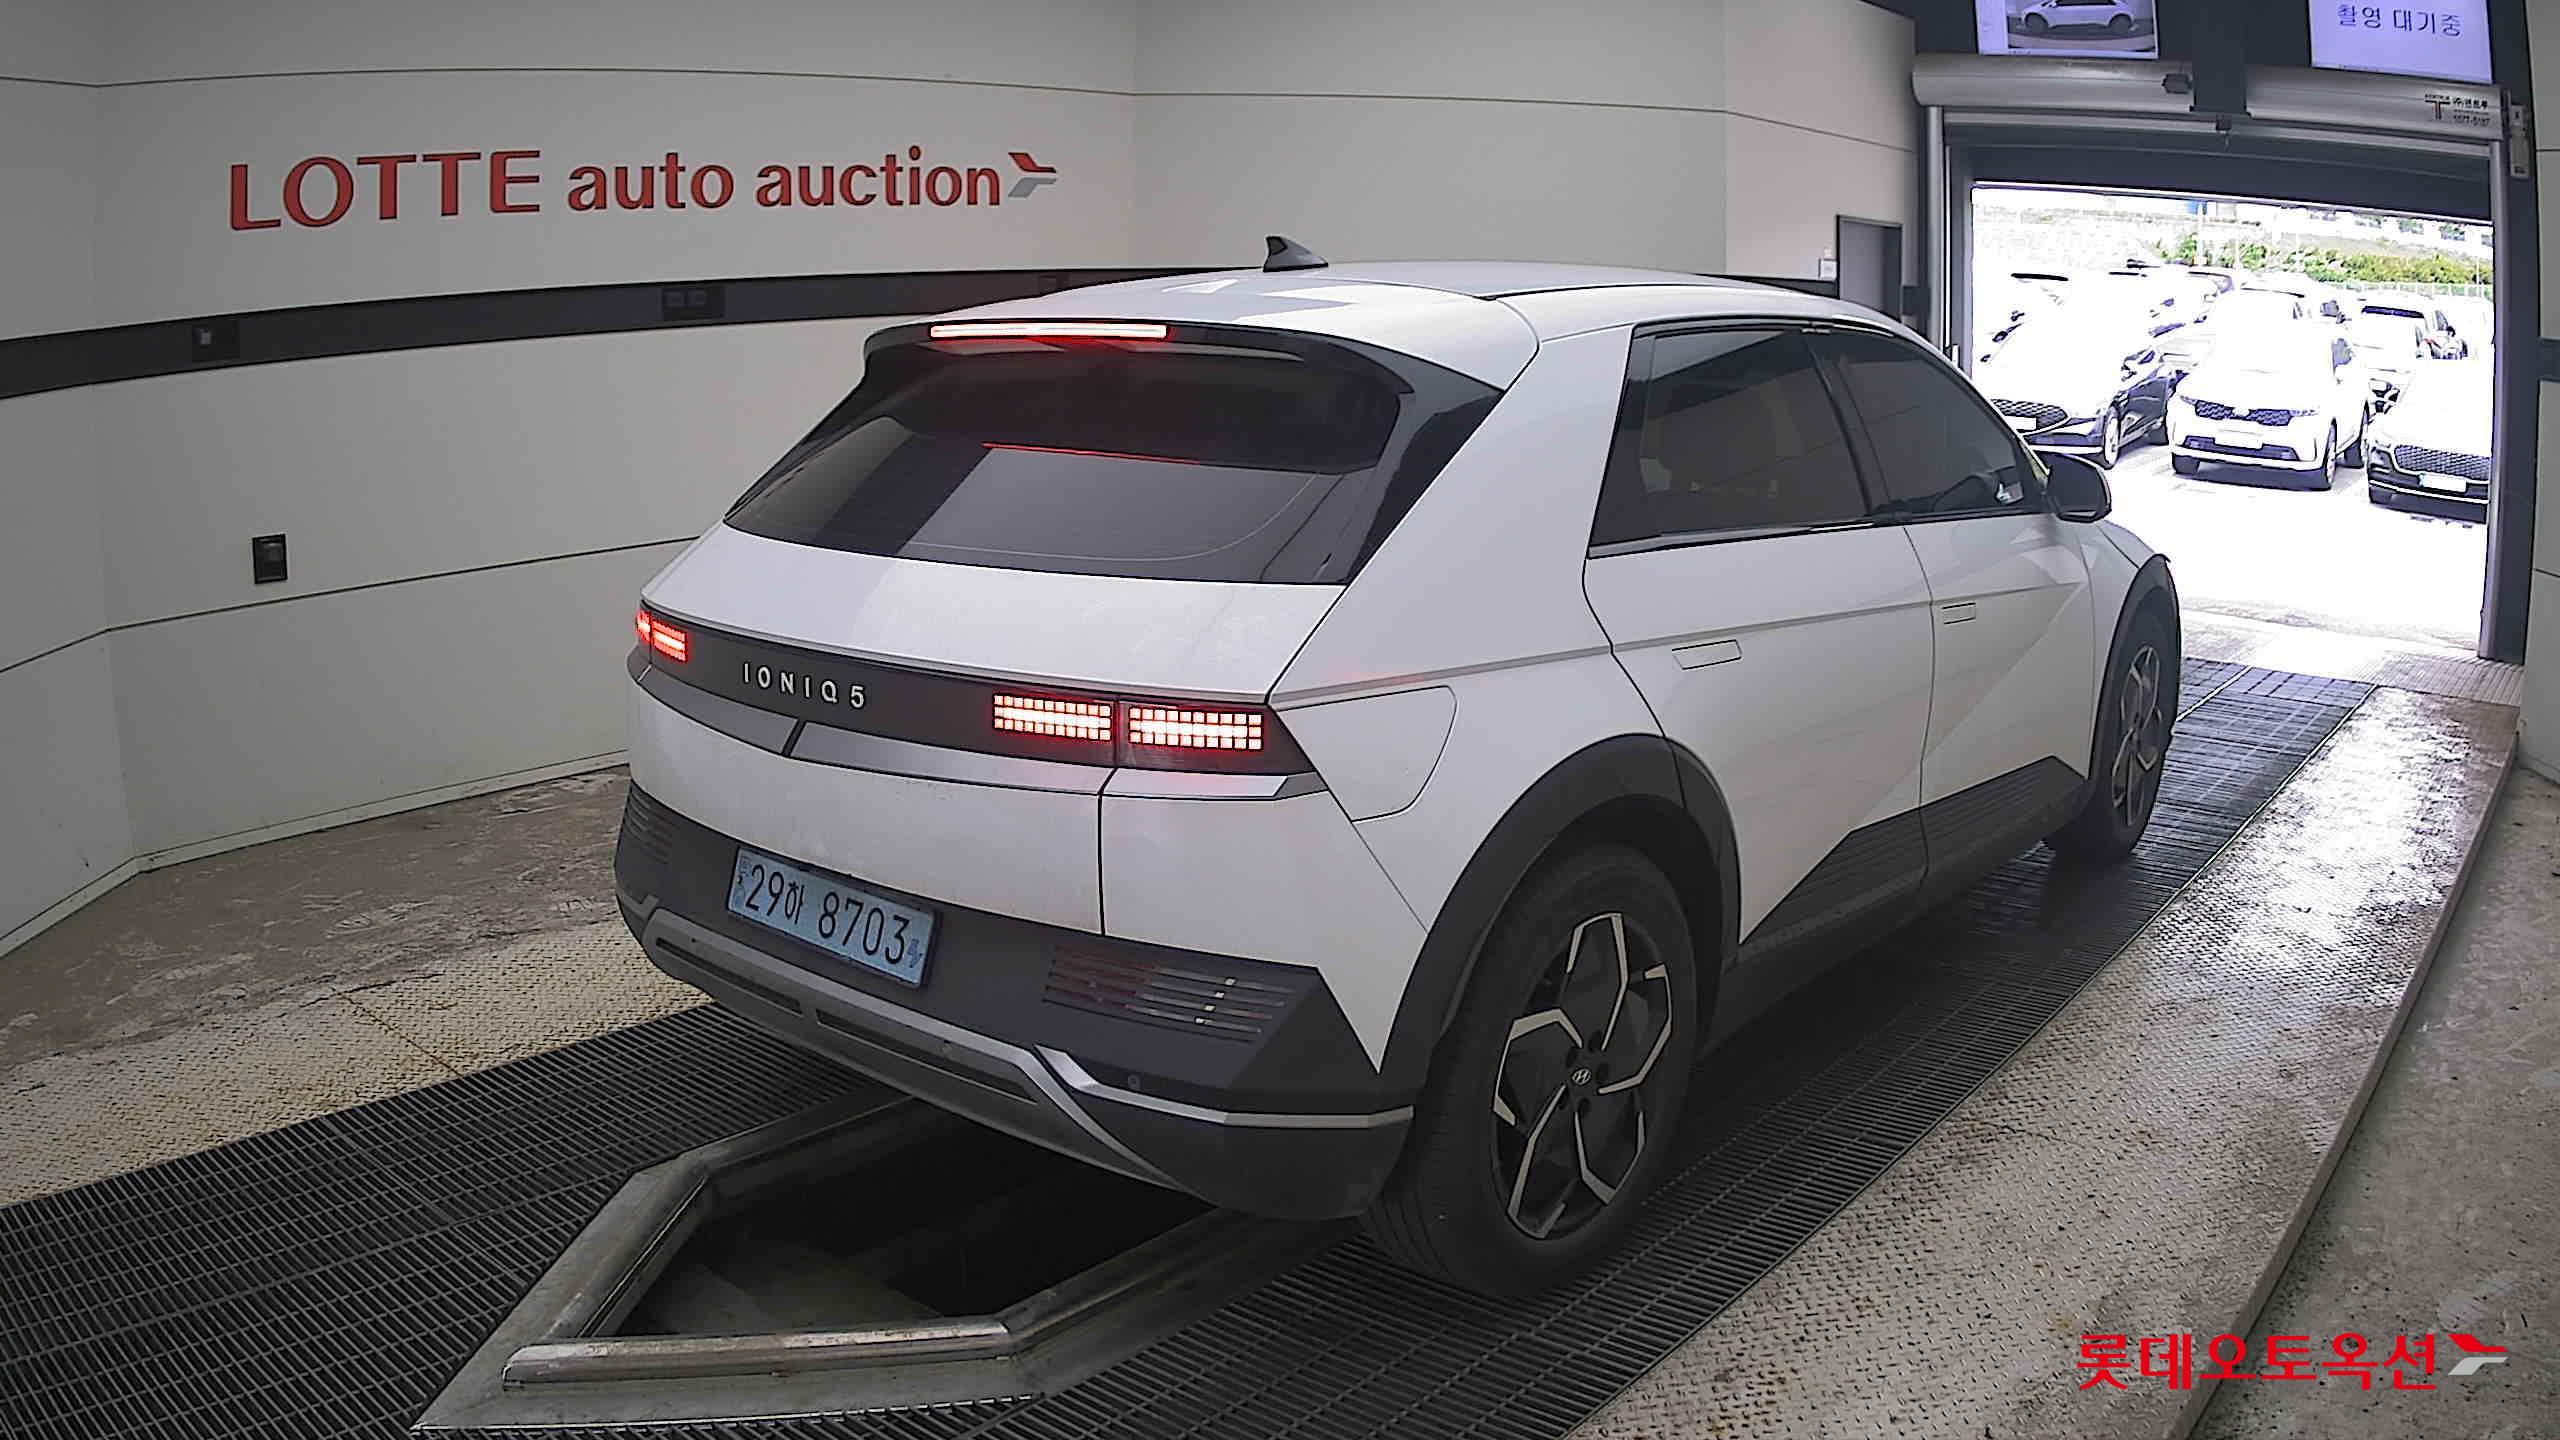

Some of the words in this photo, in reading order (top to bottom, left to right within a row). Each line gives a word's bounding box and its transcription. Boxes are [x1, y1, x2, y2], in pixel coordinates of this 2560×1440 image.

[2393, 9, 2461, 37] 대기중
[230, 149, 541, 232] LOTTE
[567, 151, 736, 211] auto
[755, 144, 1001, 208] auction
[743, 662, 838, 704] IONIQ
[850, 685, 865, 709] 5
[745, 864, 805, 925] 29하
[818, 892, 910, 965] 8703
